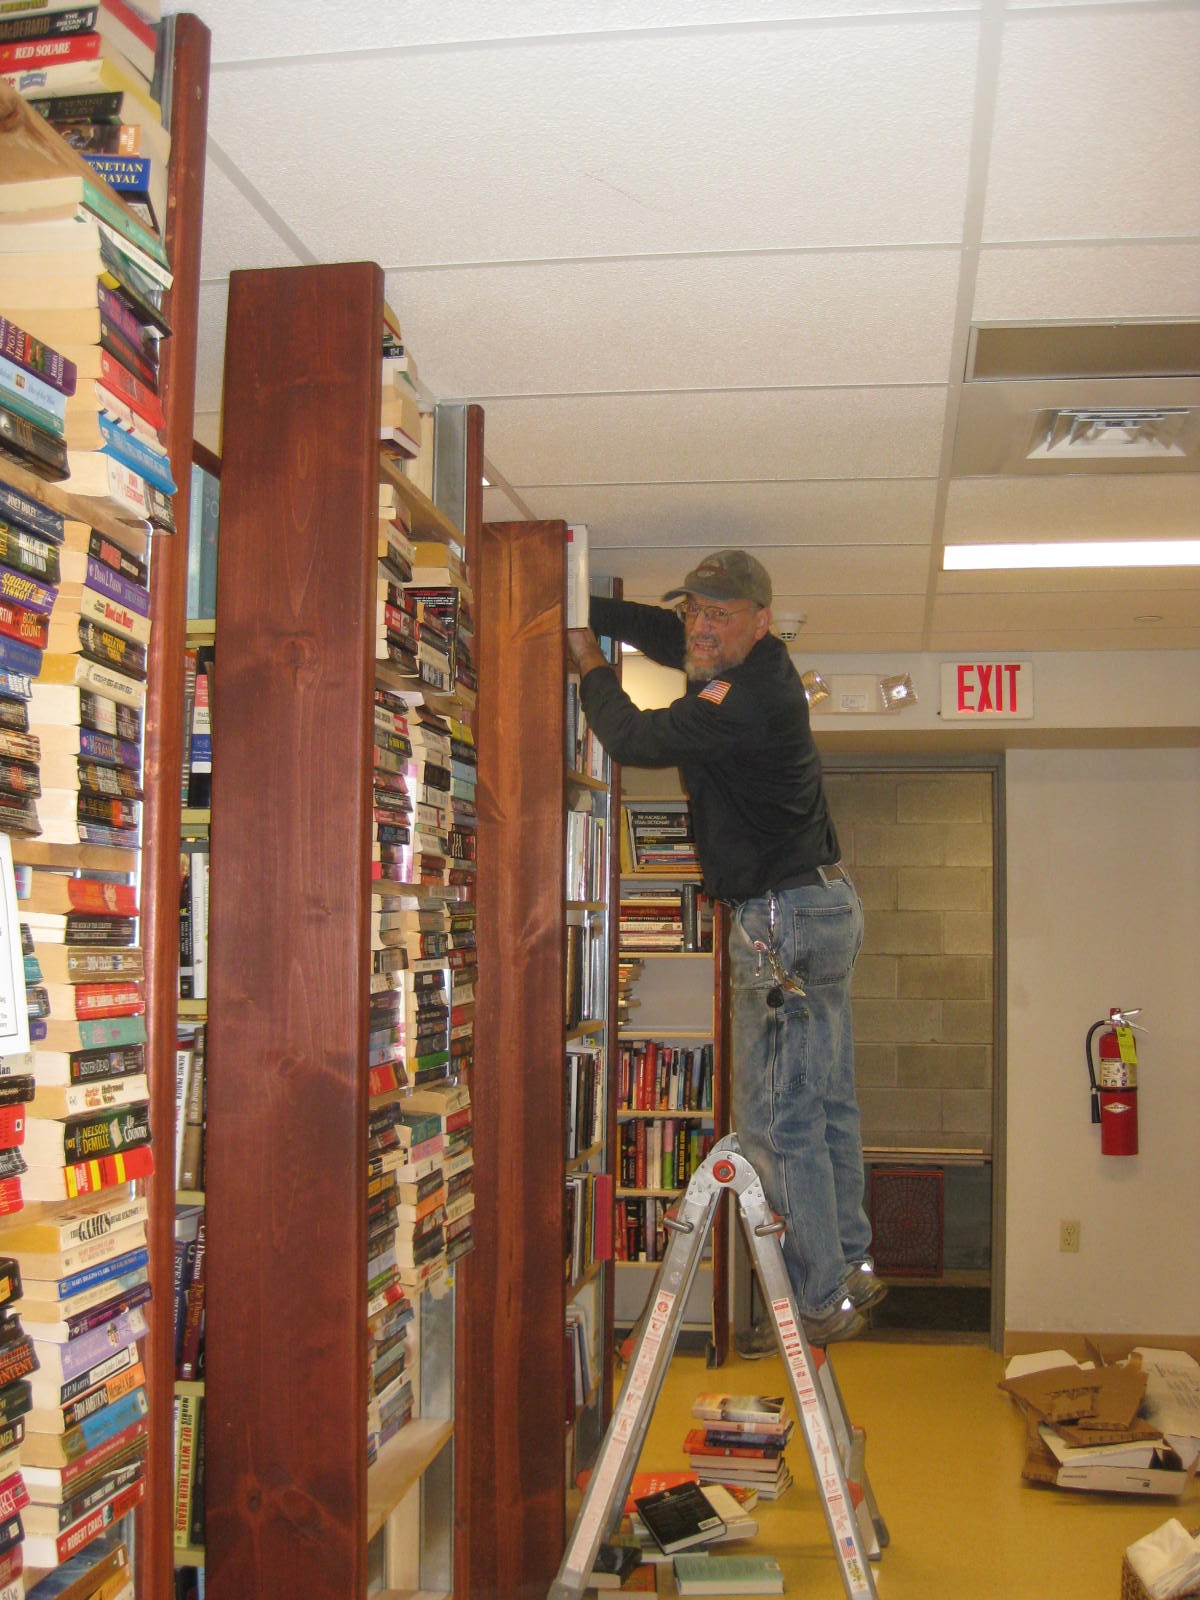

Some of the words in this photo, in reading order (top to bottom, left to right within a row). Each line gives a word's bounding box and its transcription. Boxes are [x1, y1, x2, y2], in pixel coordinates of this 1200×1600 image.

[15, 46, 34, 59] RED
[35, 42, 71, 57] SQUARE
[88, 161, 143, 172] ENETIAN
[100, 173, 139, 184] RAYAL
[0, 607, 13, 625] RTIN
[23, 612, 38, 625] BODY
[21, 624, 41, 638] COUNT
[957, 664, 1021, 713] EXIT
[82, 1122, 109, 1139] NELSON
[182, 1426, 192, 1443] OFF
[181, 1445, 191, 1469] WITH
[179, 1472, 190, 1498] THEIR
[176, 1501, 187, 1531] HEADS
[67, 1528, 88, 1552] ROBERT
